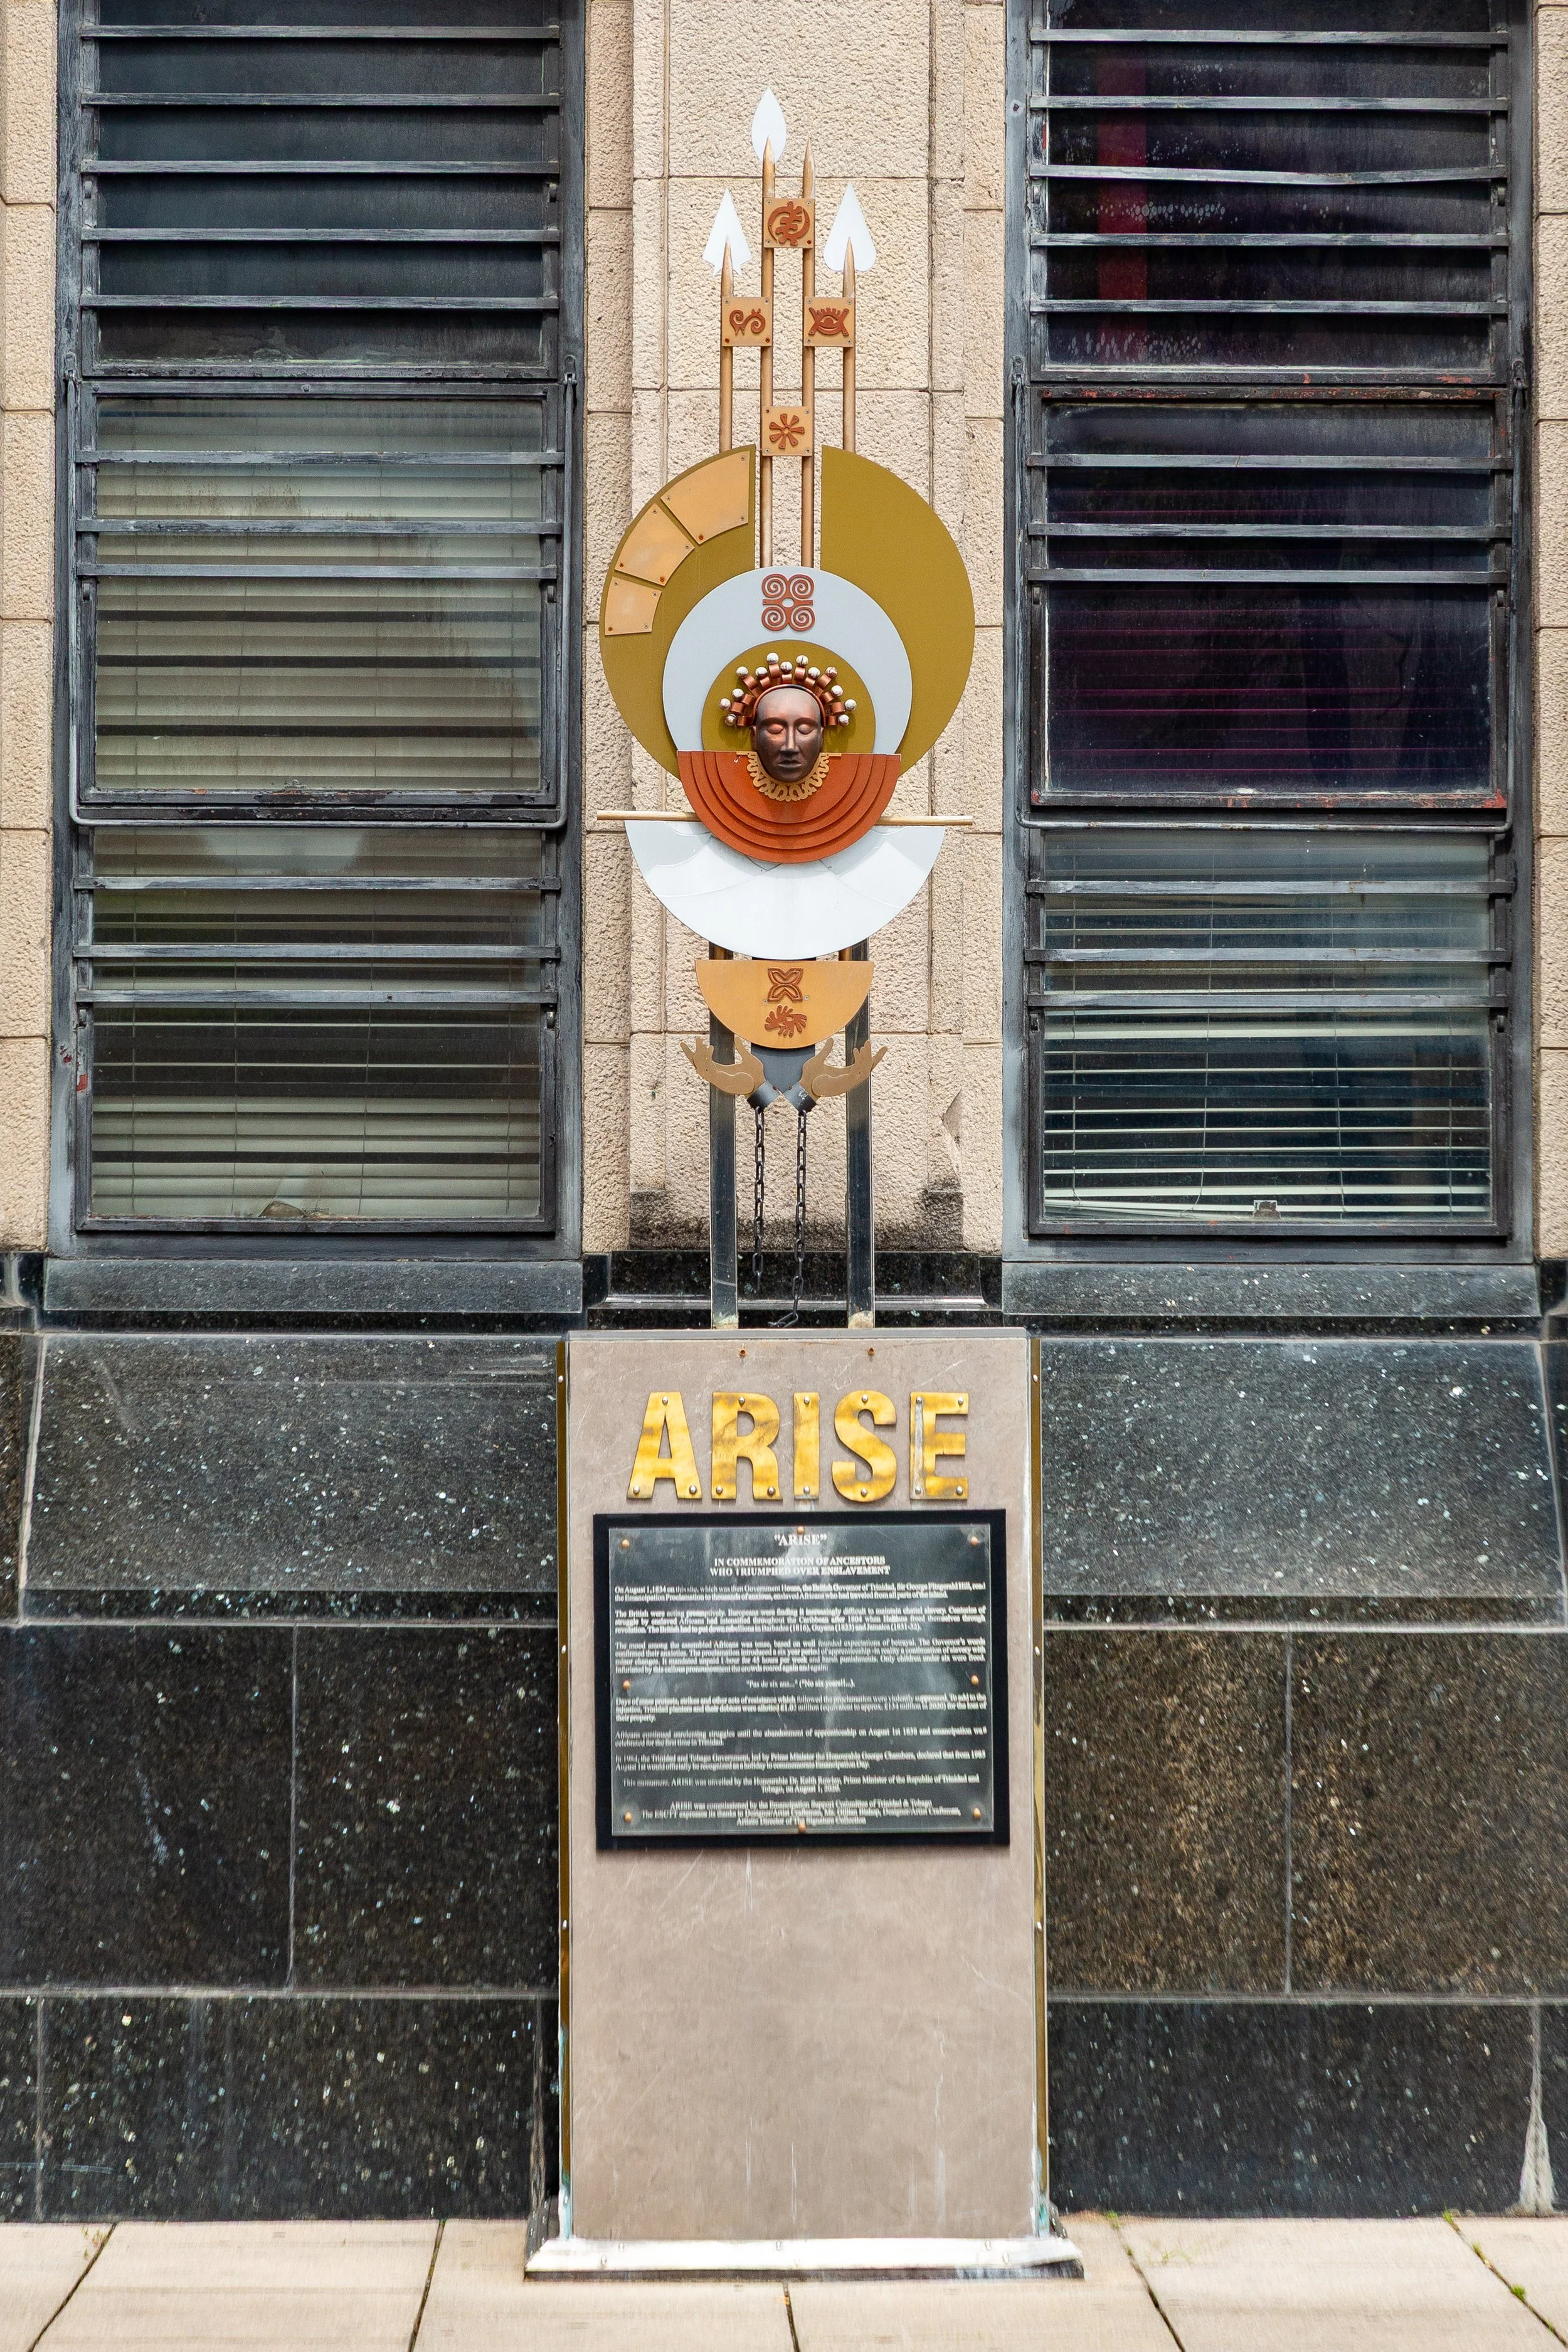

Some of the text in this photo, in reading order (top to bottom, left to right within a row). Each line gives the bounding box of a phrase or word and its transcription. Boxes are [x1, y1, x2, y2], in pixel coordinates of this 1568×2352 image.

[626, 1391, 970, 1502] ARISE
[714, 1557, 725, 1567] IN
[726, 1557, 814, 1567] COMMEMORATION
[830, 1556, 886, 1565] ANCESTORS
[710, 1567, 733, 1576] WHO
[793, 1566, 820, 1576] OVER
[821, 1565, 891, 1575] ENSLAVEMENT
